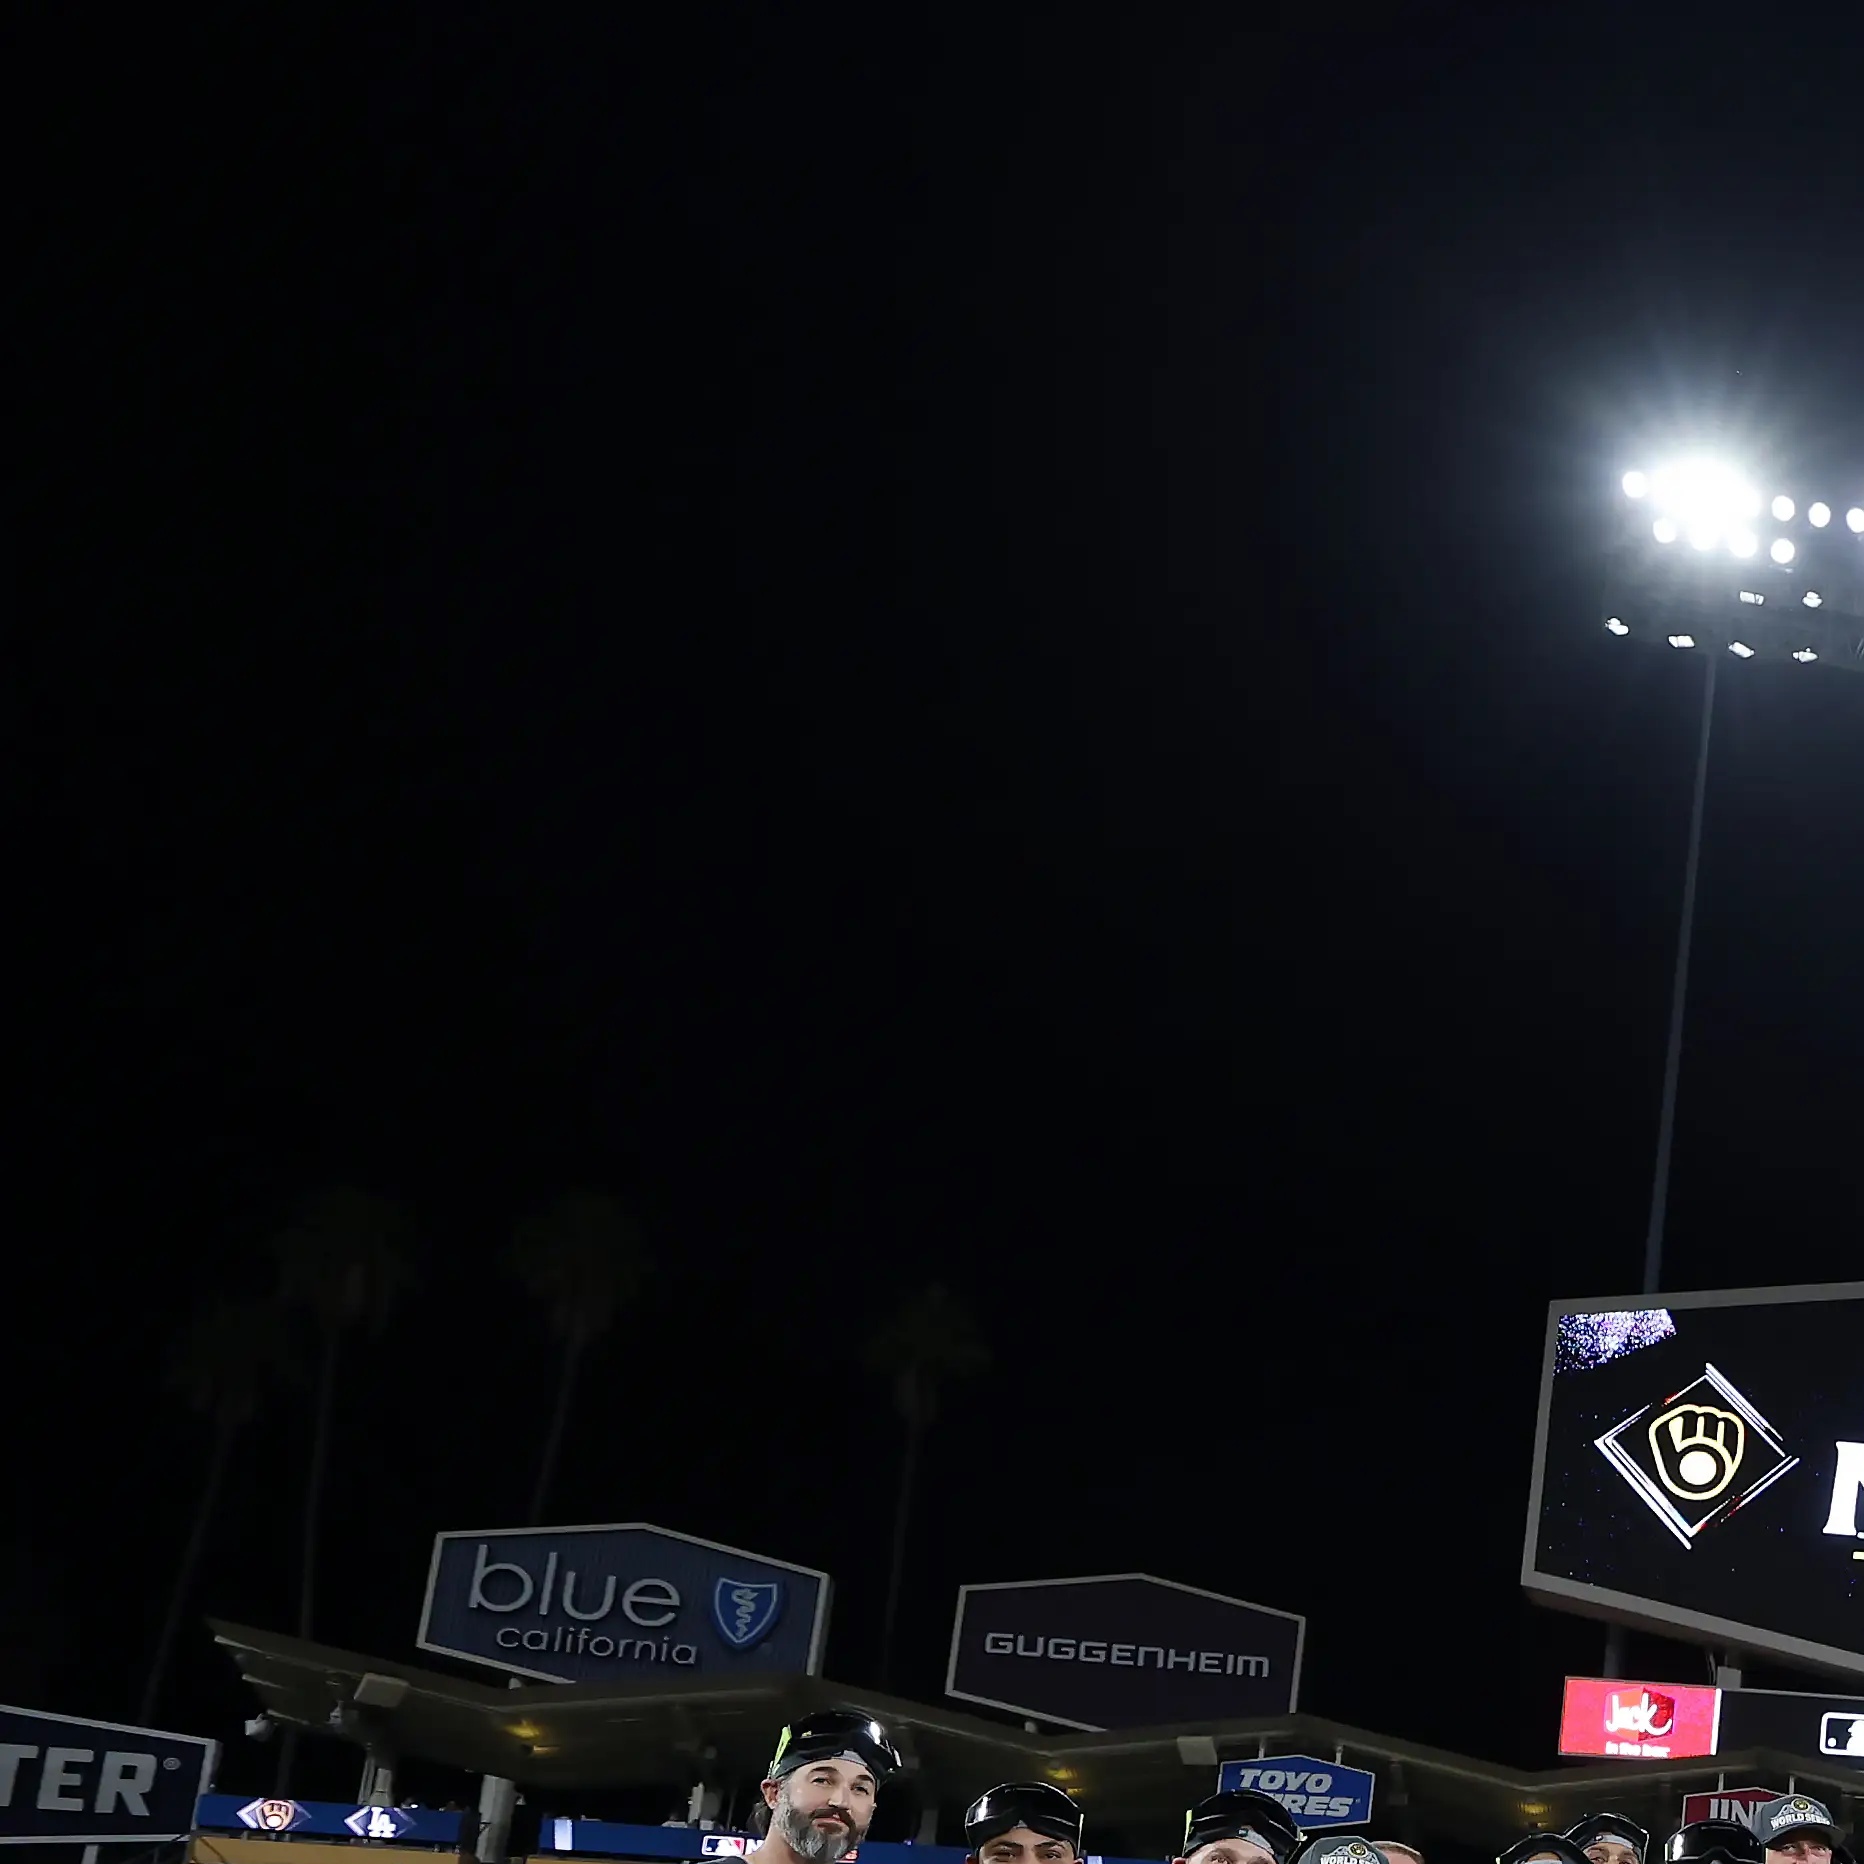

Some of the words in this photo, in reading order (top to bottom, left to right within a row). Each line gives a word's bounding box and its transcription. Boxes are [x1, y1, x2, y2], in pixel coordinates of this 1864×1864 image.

[469, 1544, 683, 1628] blue
[496, 1624, 698, 1666] california
[984, 1631, 1270, 1679] GUGGENHEIM
[1605, 1692, 1673, 1736] Jack
[1239, 1767, 1332, 1793] TOYO
